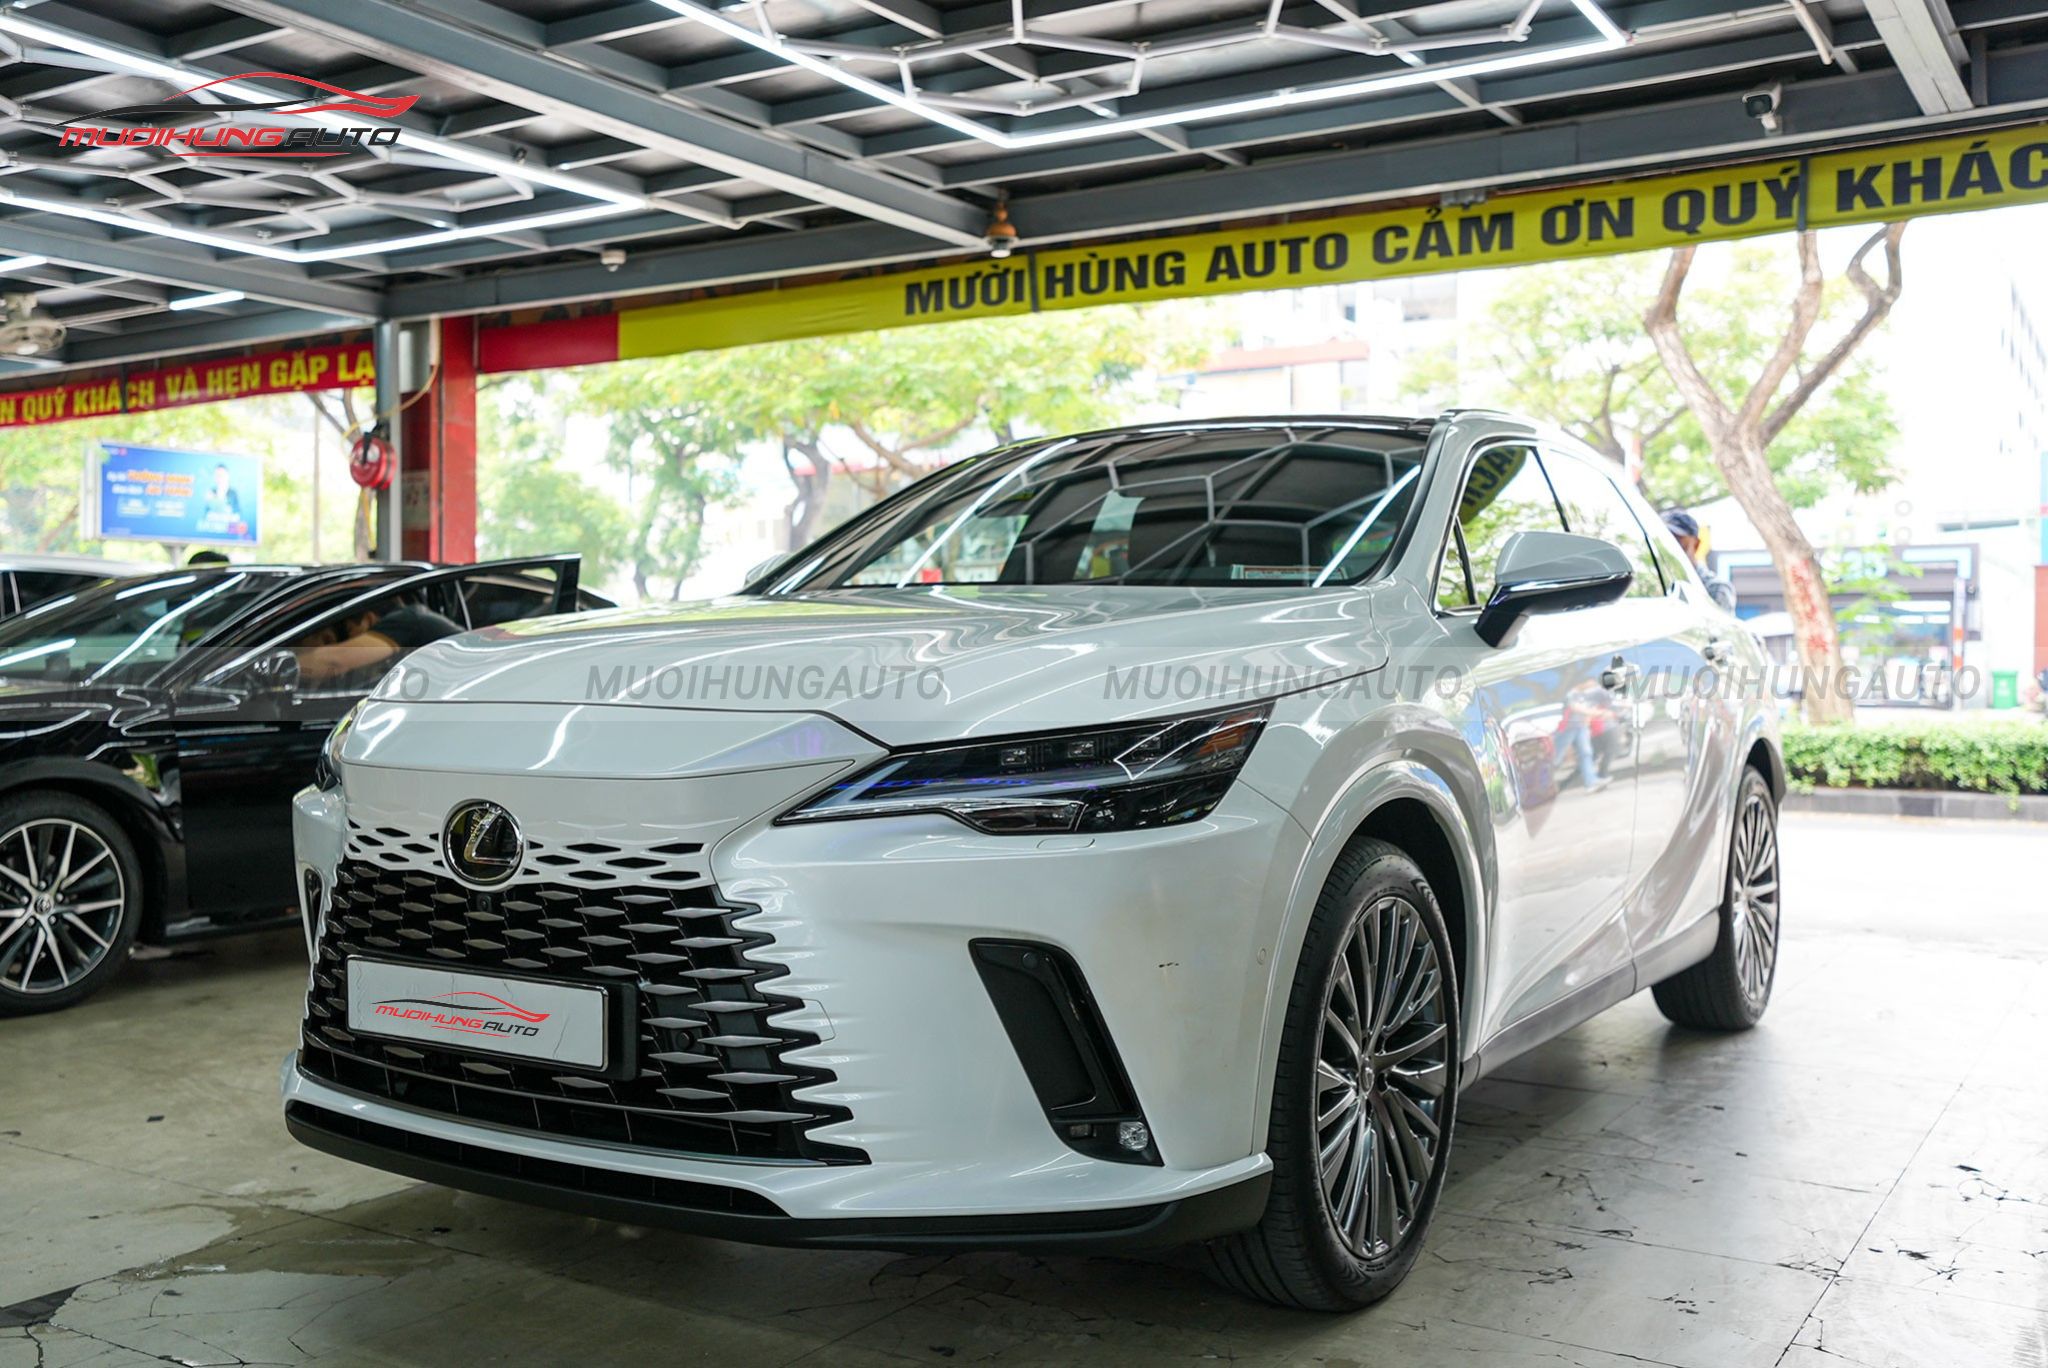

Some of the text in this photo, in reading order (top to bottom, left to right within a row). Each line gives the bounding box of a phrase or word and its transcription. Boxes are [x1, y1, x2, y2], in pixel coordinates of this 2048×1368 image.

[904, 141, 2048, 315] MƯỜI HÙNG AUTO CẢM ƠN QUÝ KHÁC
[22, 386, 67, 424] QUÝ
[73, 379, 156, 415] KHÁCH
[165, 367, 200, 401] VÀ
[207, 363, 261, 399] HẸN
[269, 355, 329, 389] GẶP
